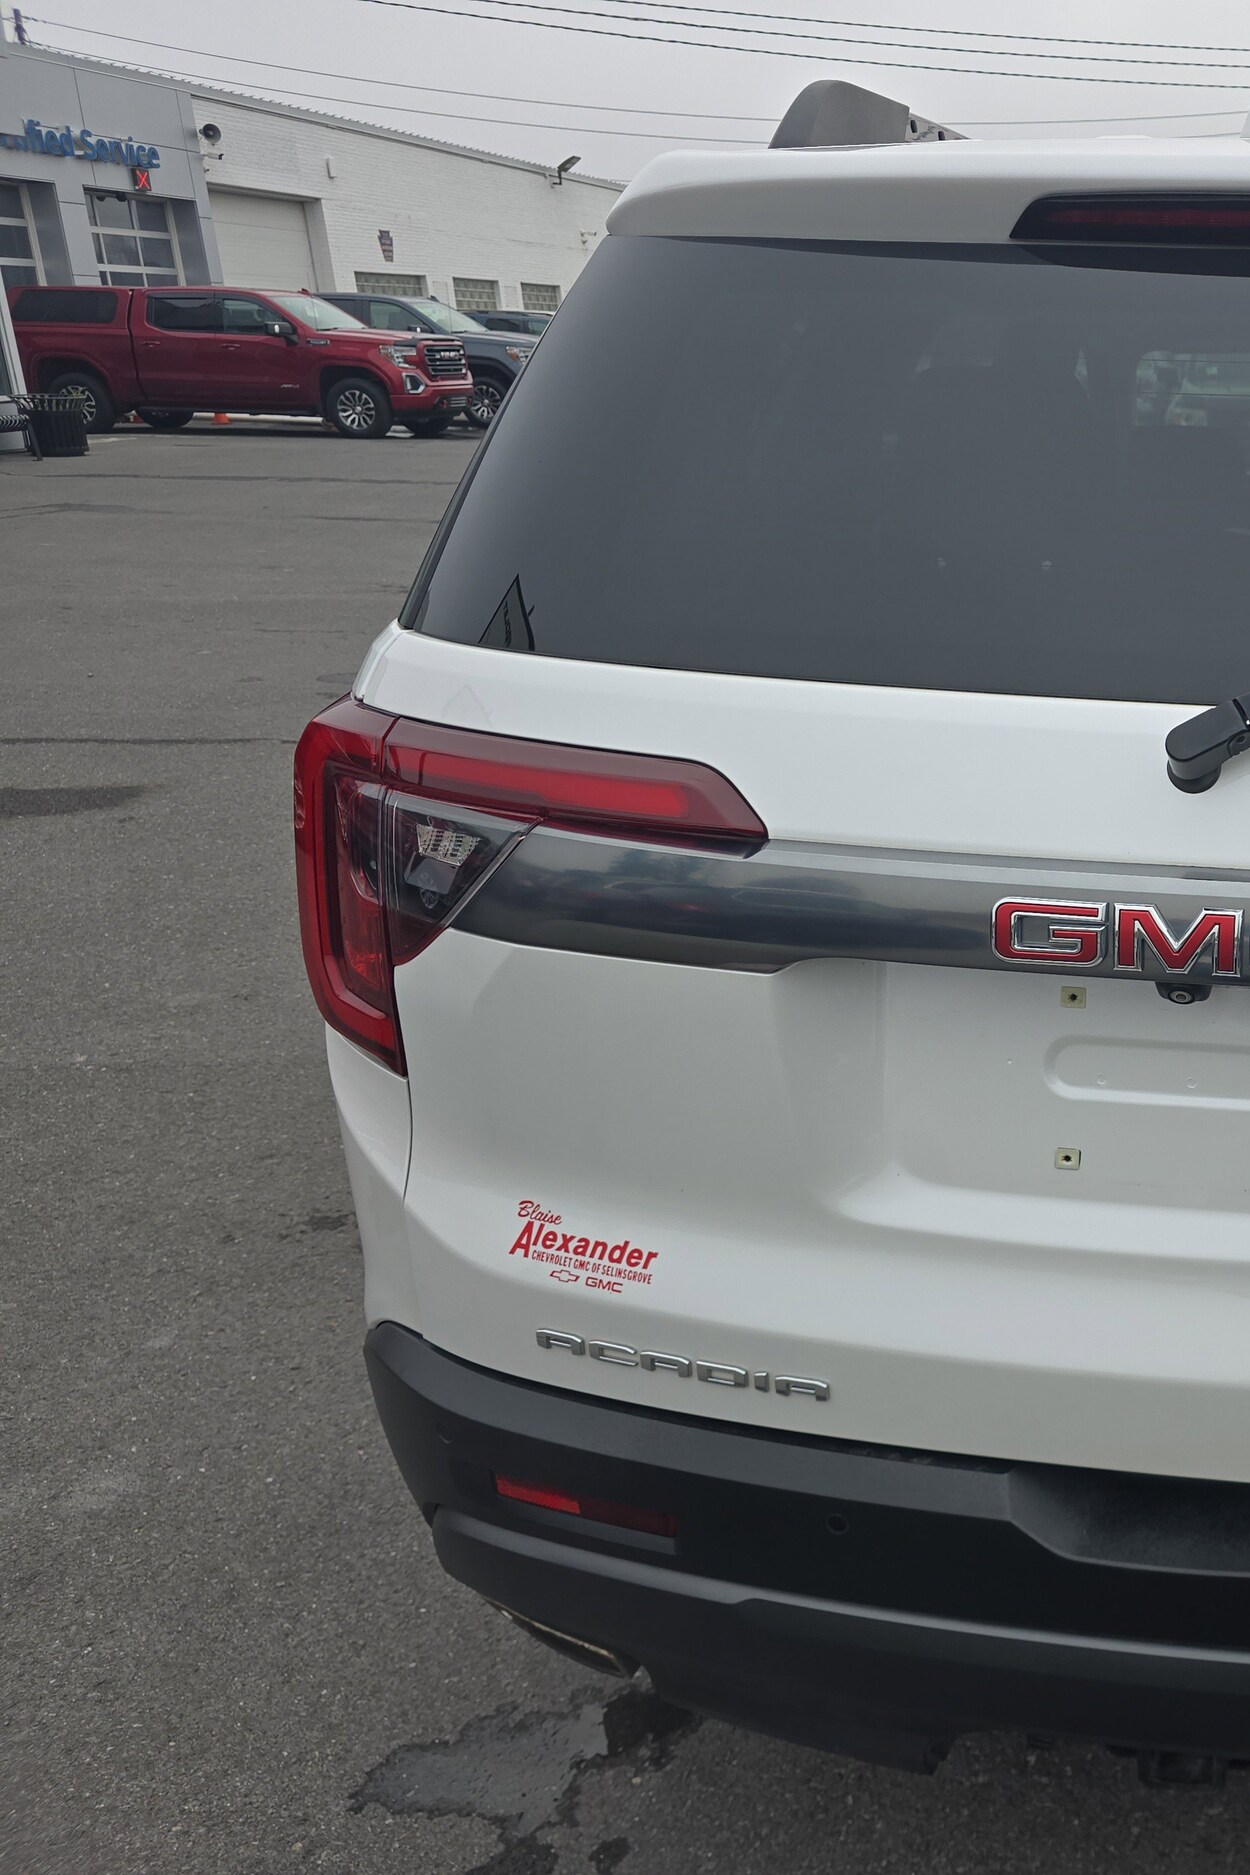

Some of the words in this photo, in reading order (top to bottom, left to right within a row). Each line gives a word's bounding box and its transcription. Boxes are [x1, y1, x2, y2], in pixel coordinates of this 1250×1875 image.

[80, 129, 161, 169] Service
[517, 1200, 562, 1225] Blaise
[508, 1220, 659, 1270] Alexander
[531, 1249, 573, 1268] CHEVROLET
[573, 1260, 590, 1272] GMC
[591, 1262, 602, 1273] OF
[601, 1265, 653, 1285] SELINSGROVE
[585, 1276, 624, 1294] GMC
[536, 1327, 830, 1401] ACADIA
